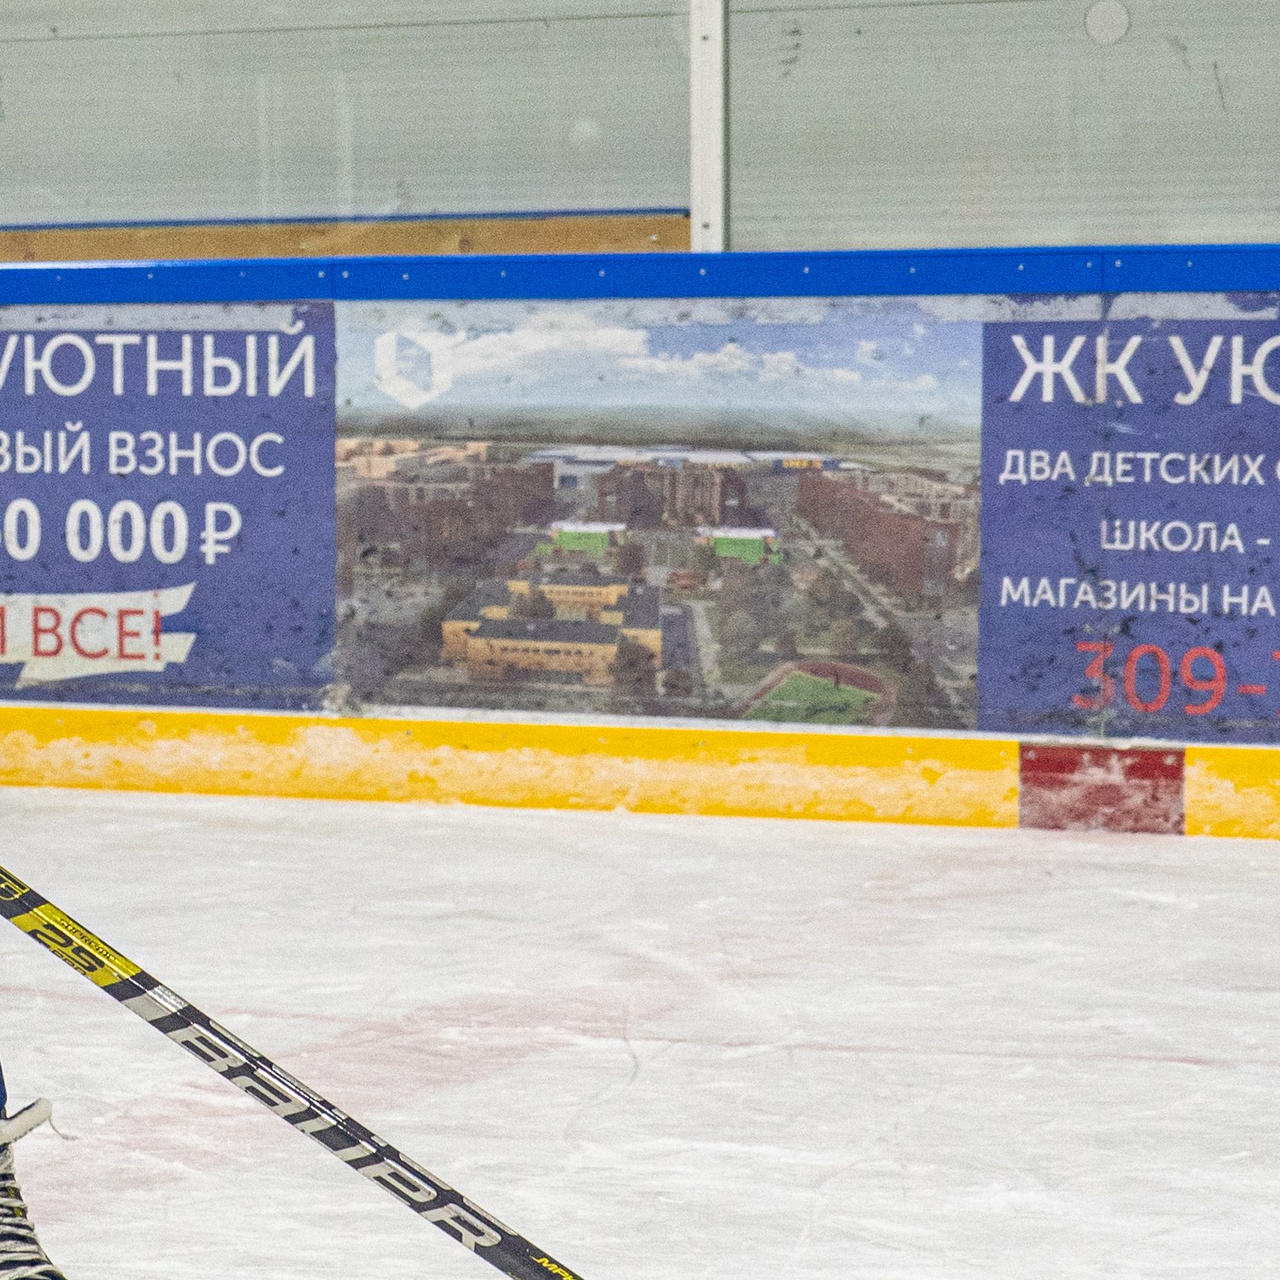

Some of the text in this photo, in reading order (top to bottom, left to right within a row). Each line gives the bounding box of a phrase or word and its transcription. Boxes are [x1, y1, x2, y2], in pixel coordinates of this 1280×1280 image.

[1009, 334, 1280, 406] ЖК УЮ
[108, 430, 286, 478] ВЗНОС
[999, 449, 1266, 487] ДВА ДЕТСКИХ
[1102, 520, 1245, 553] ШКОЛА
[1000, 577, 1277, 618] МАГАЗИНЫ НА
[32, 606, 163, 662] ВСЕ!
[1073, 640, 1280, 717] 309-
